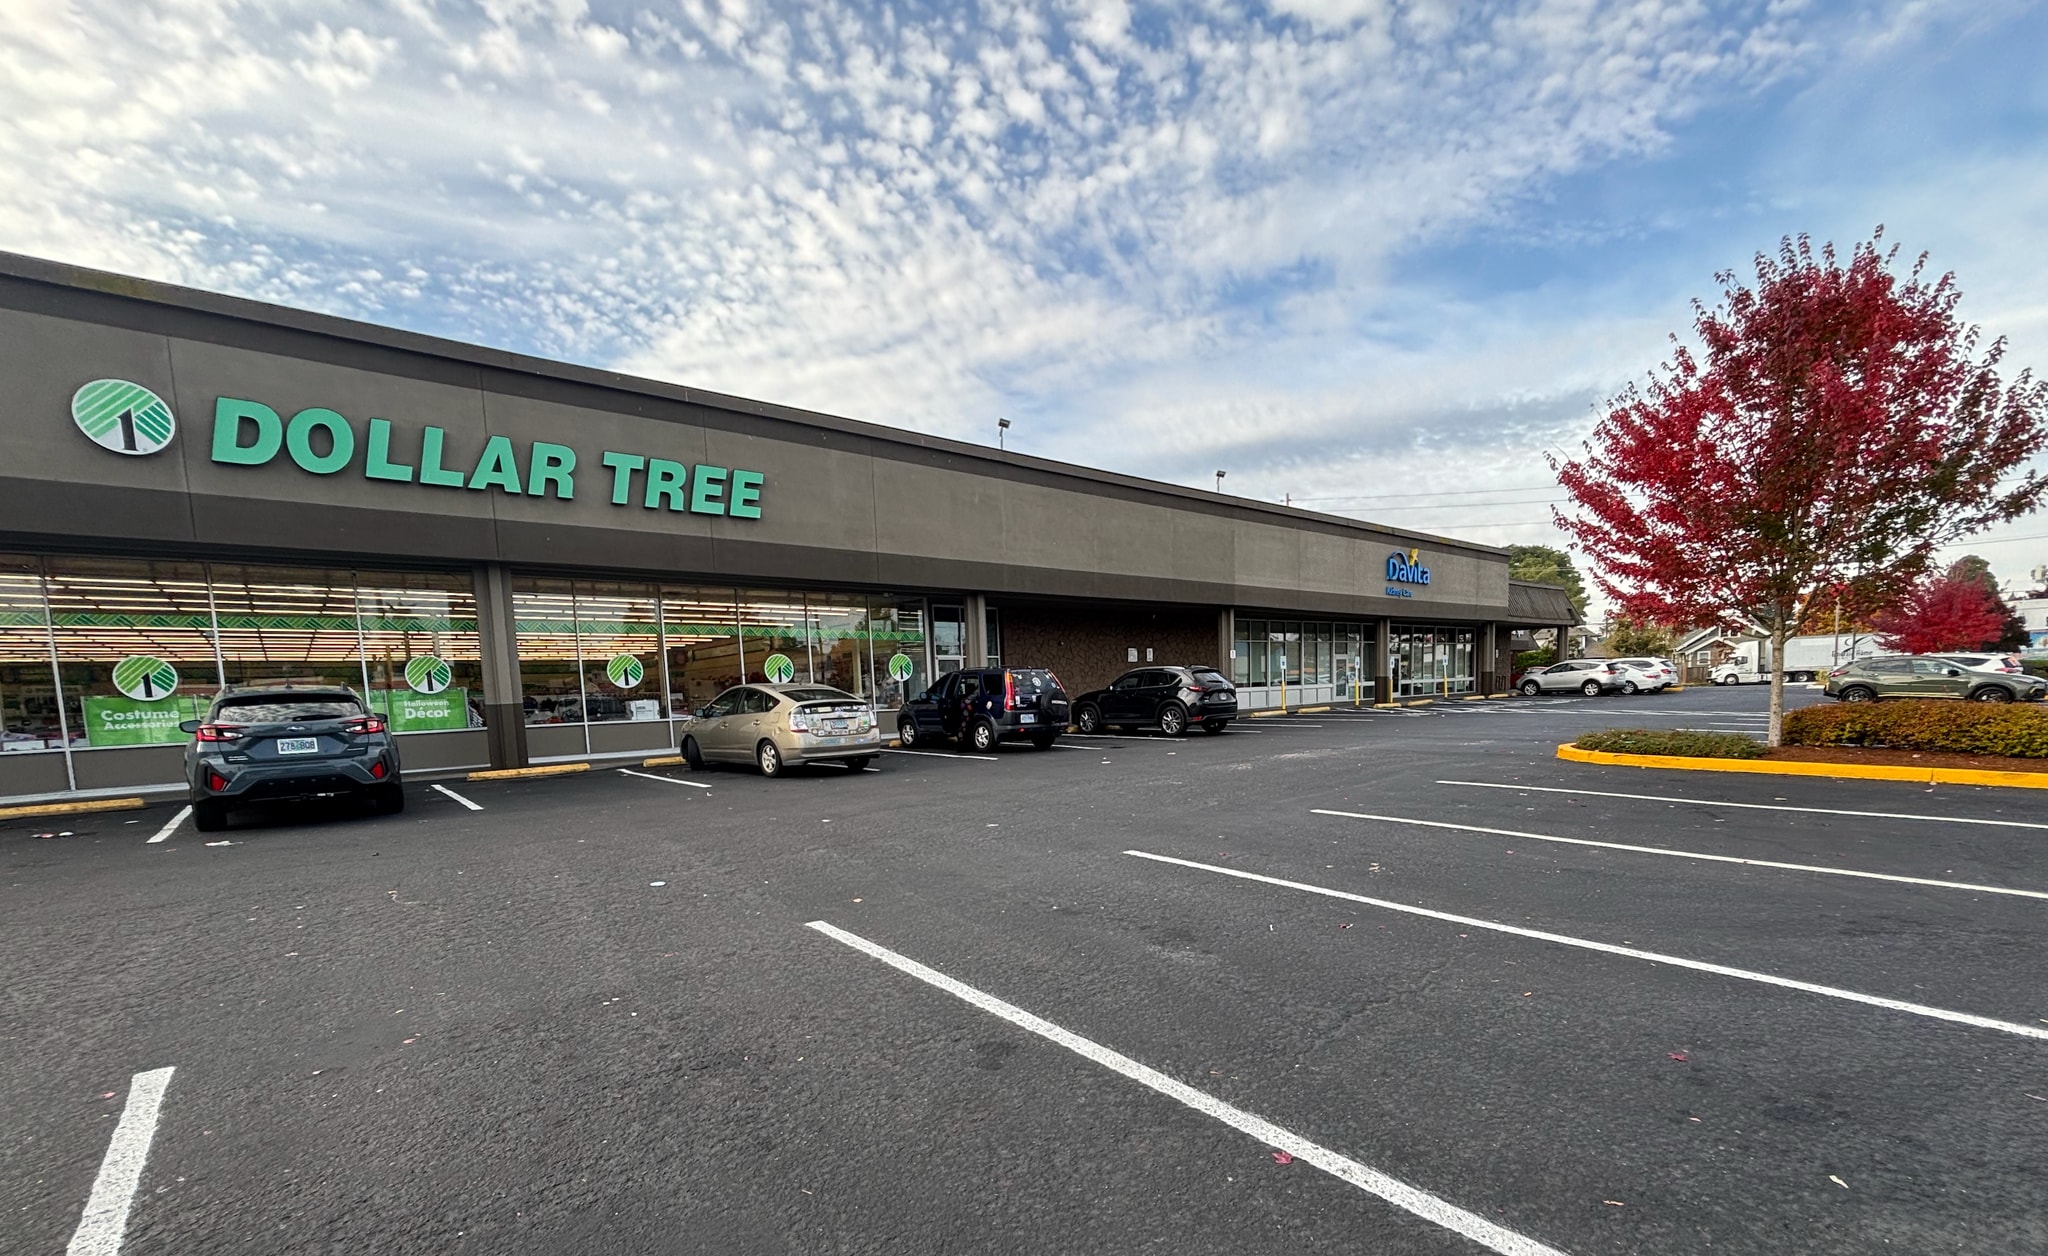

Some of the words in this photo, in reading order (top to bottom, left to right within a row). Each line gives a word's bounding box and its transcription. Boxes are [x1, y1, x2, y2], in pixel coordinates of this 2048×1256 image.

[211, 396, 577, 499] DOLLAR
[602, 451, 765, 519] TREE
[1386, 548, 1431, 585] DaVita
[101, 710, 179, 721] Costume
[405, 707, 451, 719] Décor
